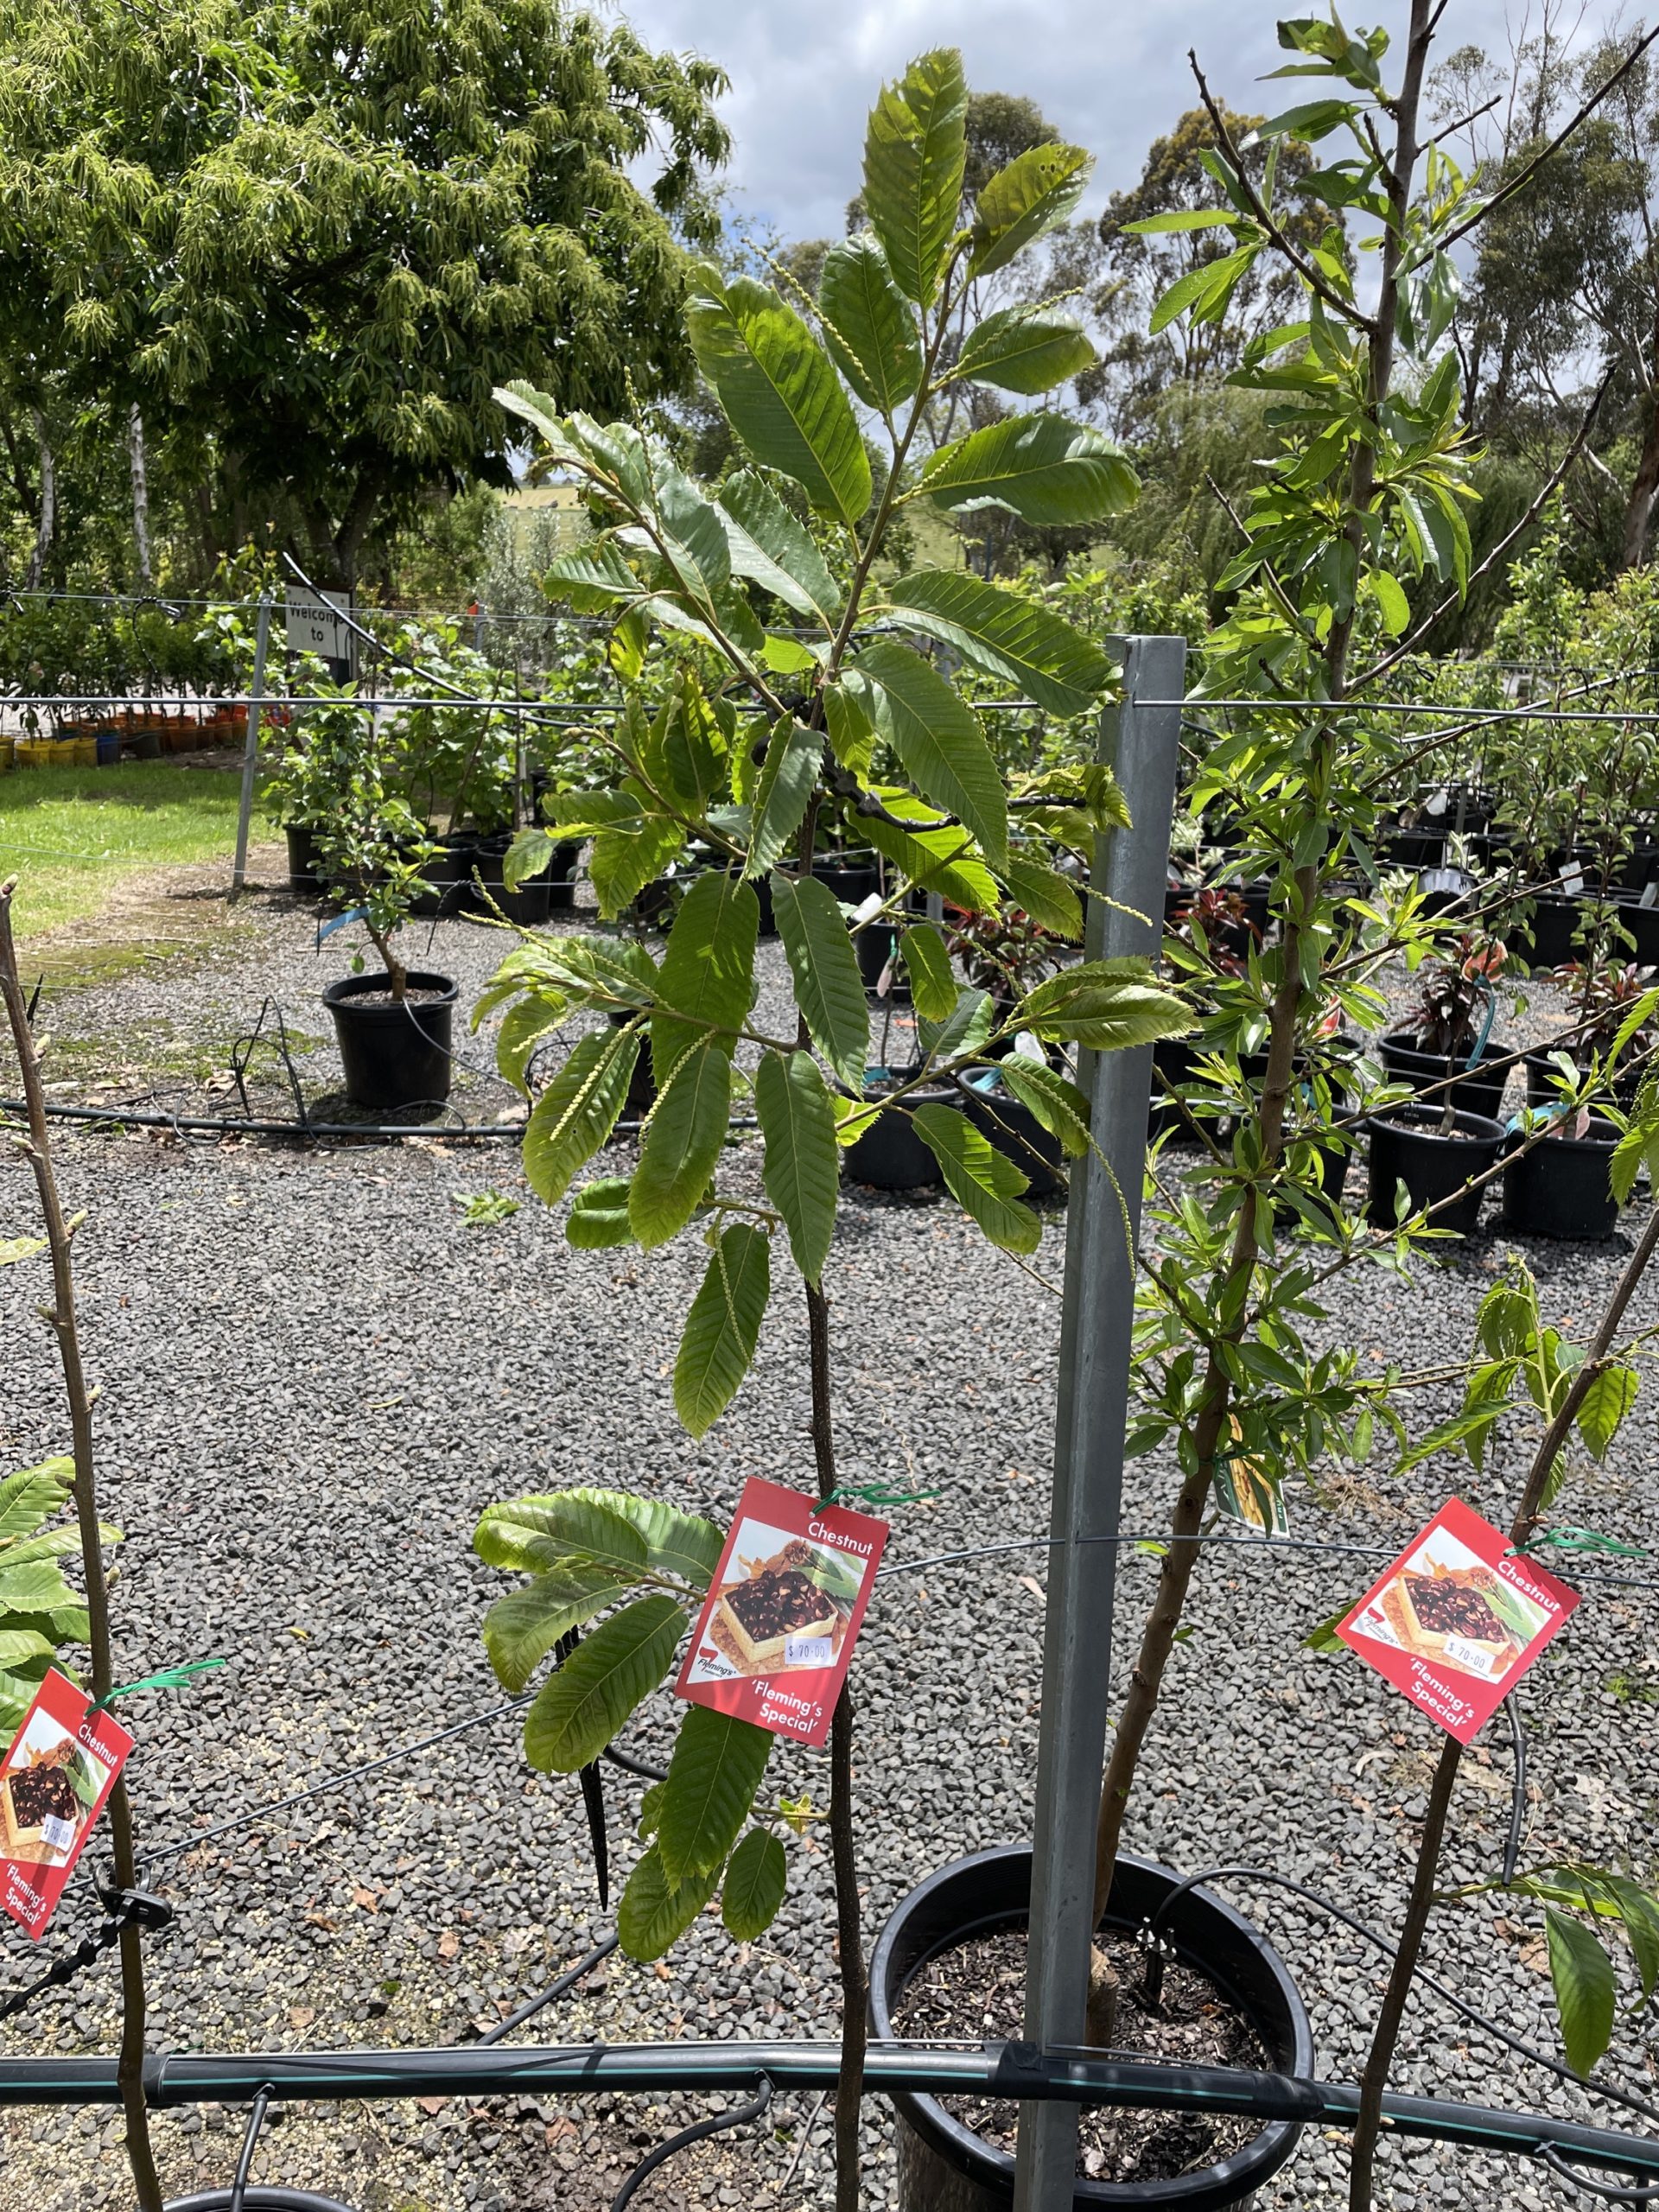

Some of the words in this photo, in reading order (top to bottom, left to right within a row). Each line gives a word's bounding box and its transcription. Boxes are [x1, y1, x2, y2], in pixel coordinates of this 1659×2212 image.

[311, 627, 324, 642] to
[808, 1522, 874, 1555] Chestnut
[1497, 1560, 1562, 1612] Chestnut
[79, 1724, 118, 1767] Chestnut
